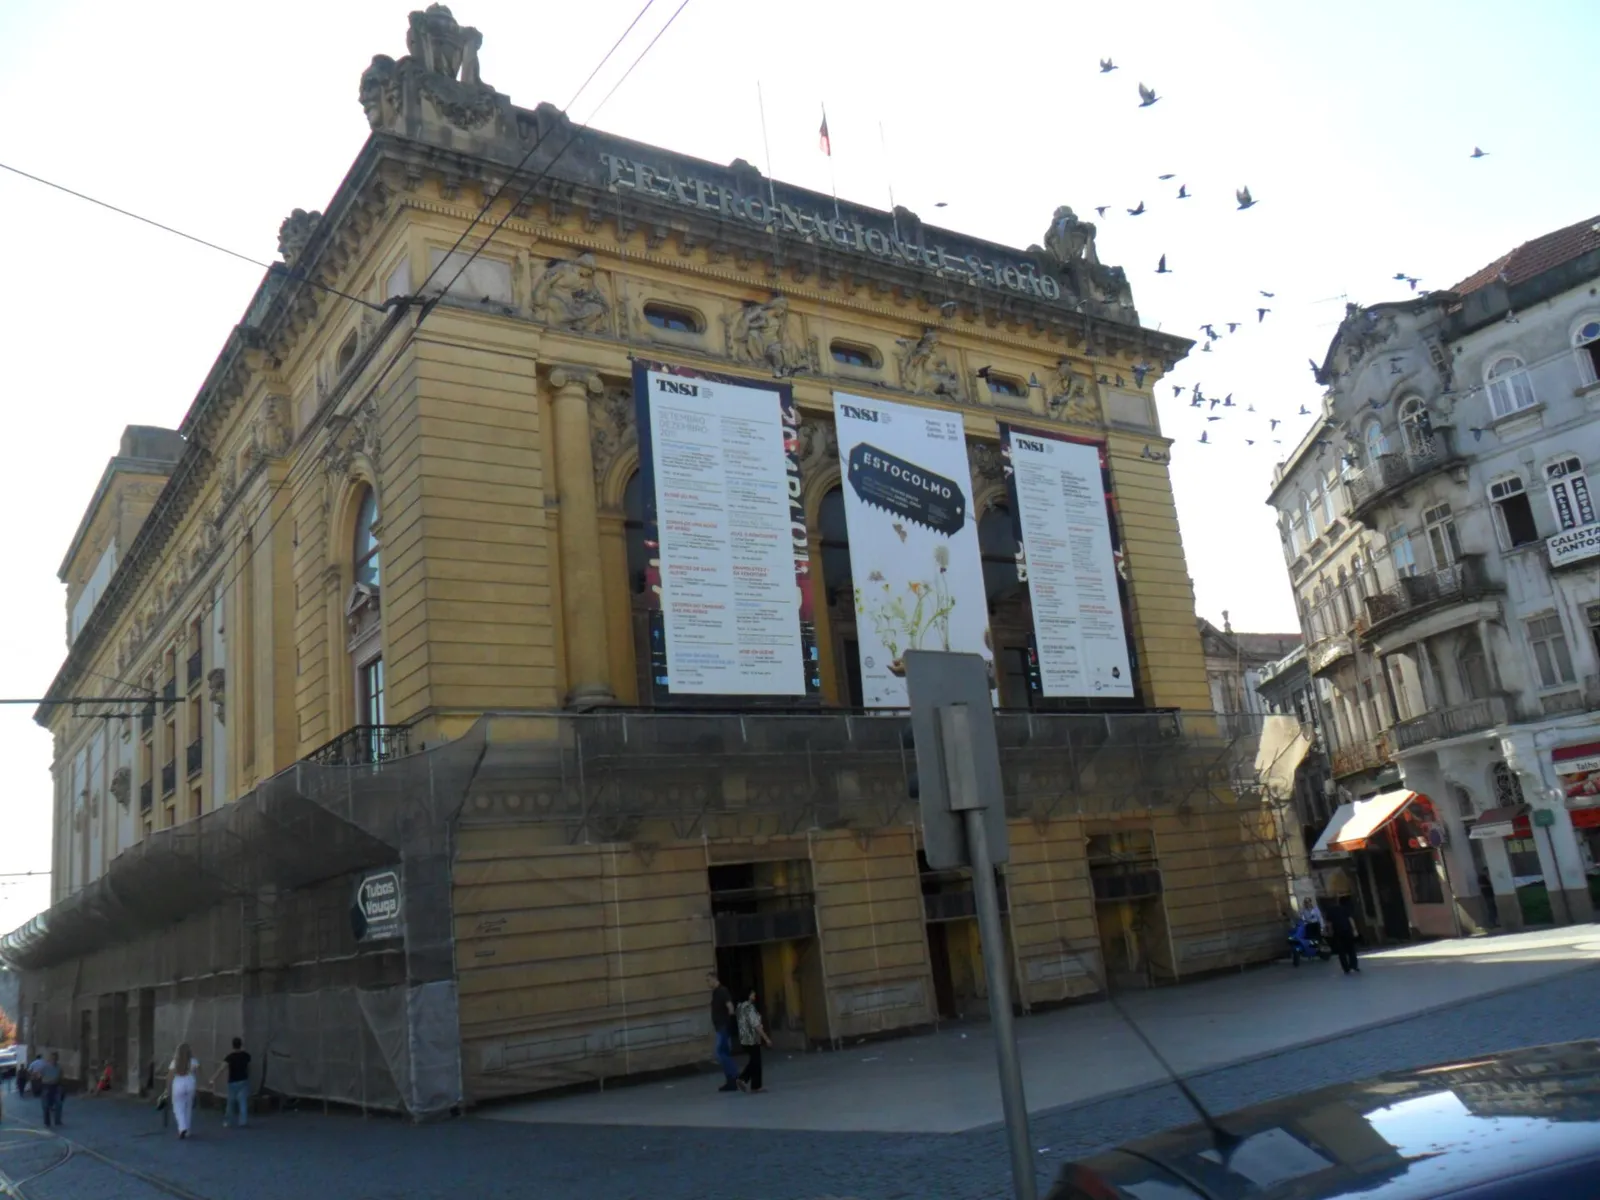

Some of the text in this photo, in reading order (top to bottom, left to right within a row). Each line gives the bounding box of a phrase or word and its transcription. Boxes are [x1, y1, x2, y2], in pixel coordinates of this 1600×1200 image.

[599, 152, 772, 224] TEATRO
[779, 203, 949, 269] NACIONAL
[656, 378, 698, 397] TNSJ
[840, 404, 879, 423] TNSJ
[1016, 438, 1044, 453] TNSJ
[863, 451, 952, 499] ESTOCOLMO
[1574, 480, 1593, 521] SANTOS
[1551, 527, 1600, 547] CALISTA
[1556, 536, 1600, 556] SANTOS
[365, 882, 394, 898] Tubos
[366, 899, 396, 917] Vouga
